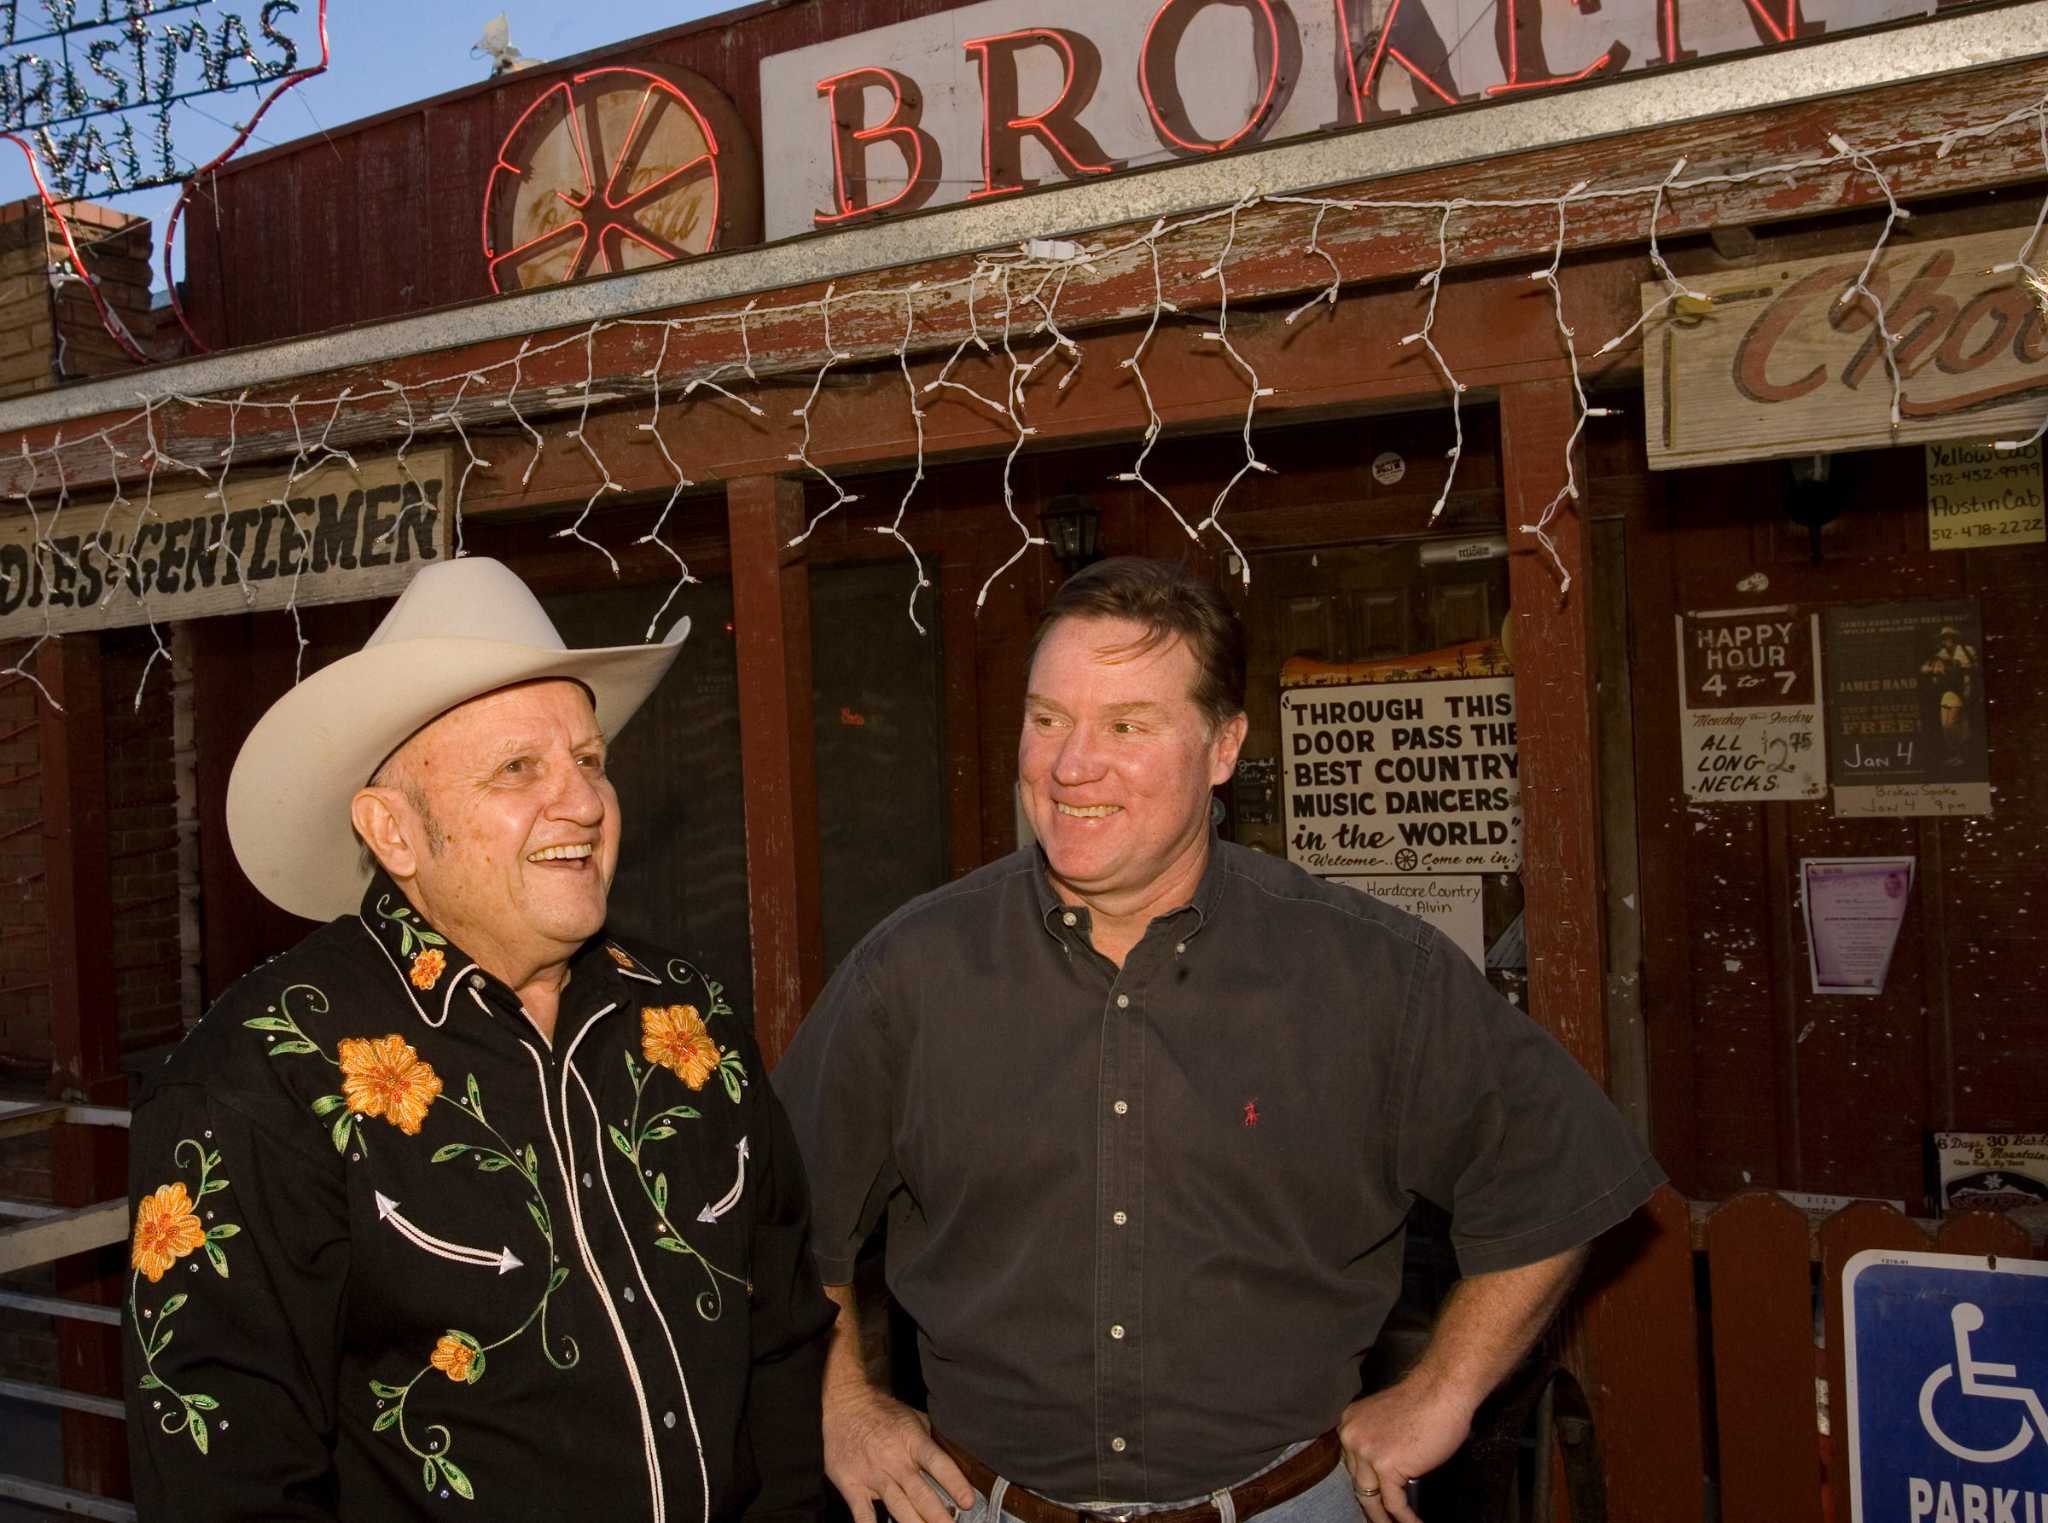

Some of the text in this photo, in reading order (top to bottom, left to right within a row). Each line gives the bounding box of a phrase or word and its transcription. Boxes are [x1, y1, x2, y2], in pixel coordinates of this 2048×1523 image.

[1930, 445, 1993, 468] Yellow
[1931, 488, 2041, 517] Austin Cab
[126, 478, 443, 598] GENTLEMEN
[1931, 518, 2044, 541] 512-478-2222
[1696, 621, 1794, 649] HAPPY
[1706, 646, 1786, 670] HOUR
[1701, 671, 1797, 697] 4 to 7
[1839, 677, 1919, 693] JAMES HAND
[1444, 692, 1513, 719] THIS
[1292, 721, 1517, 756] DOOR PASS THE
[1700, 734, 1743, 751] ALL
[1696, 754, 1766, 772] LONG
[1844, 741, 1913, 769] Jan 4
[1293, 753, 1520, 787] BEST COUNTRY
[1698, 774, 1778, 793] NECKS
[1292, 791, 1377, 818] MUSIC
[1385, 786, 1510, 815] DANCERS
[1291, 824, 1327, 851] in
[1331, 822, 1395, 849] the
[1421, 852, 1462, 865] Come
[1465, 855, 1486, 865] on
[1366, 880, 1481, 903] Hardcore Country
[1416, 899, 1453, 914] Alvin
[1936, 1137, 1948, 1149] 6
[1986, 1135, 2009, 1147] 30
[1974, 1148, 1985, 1160] 5
